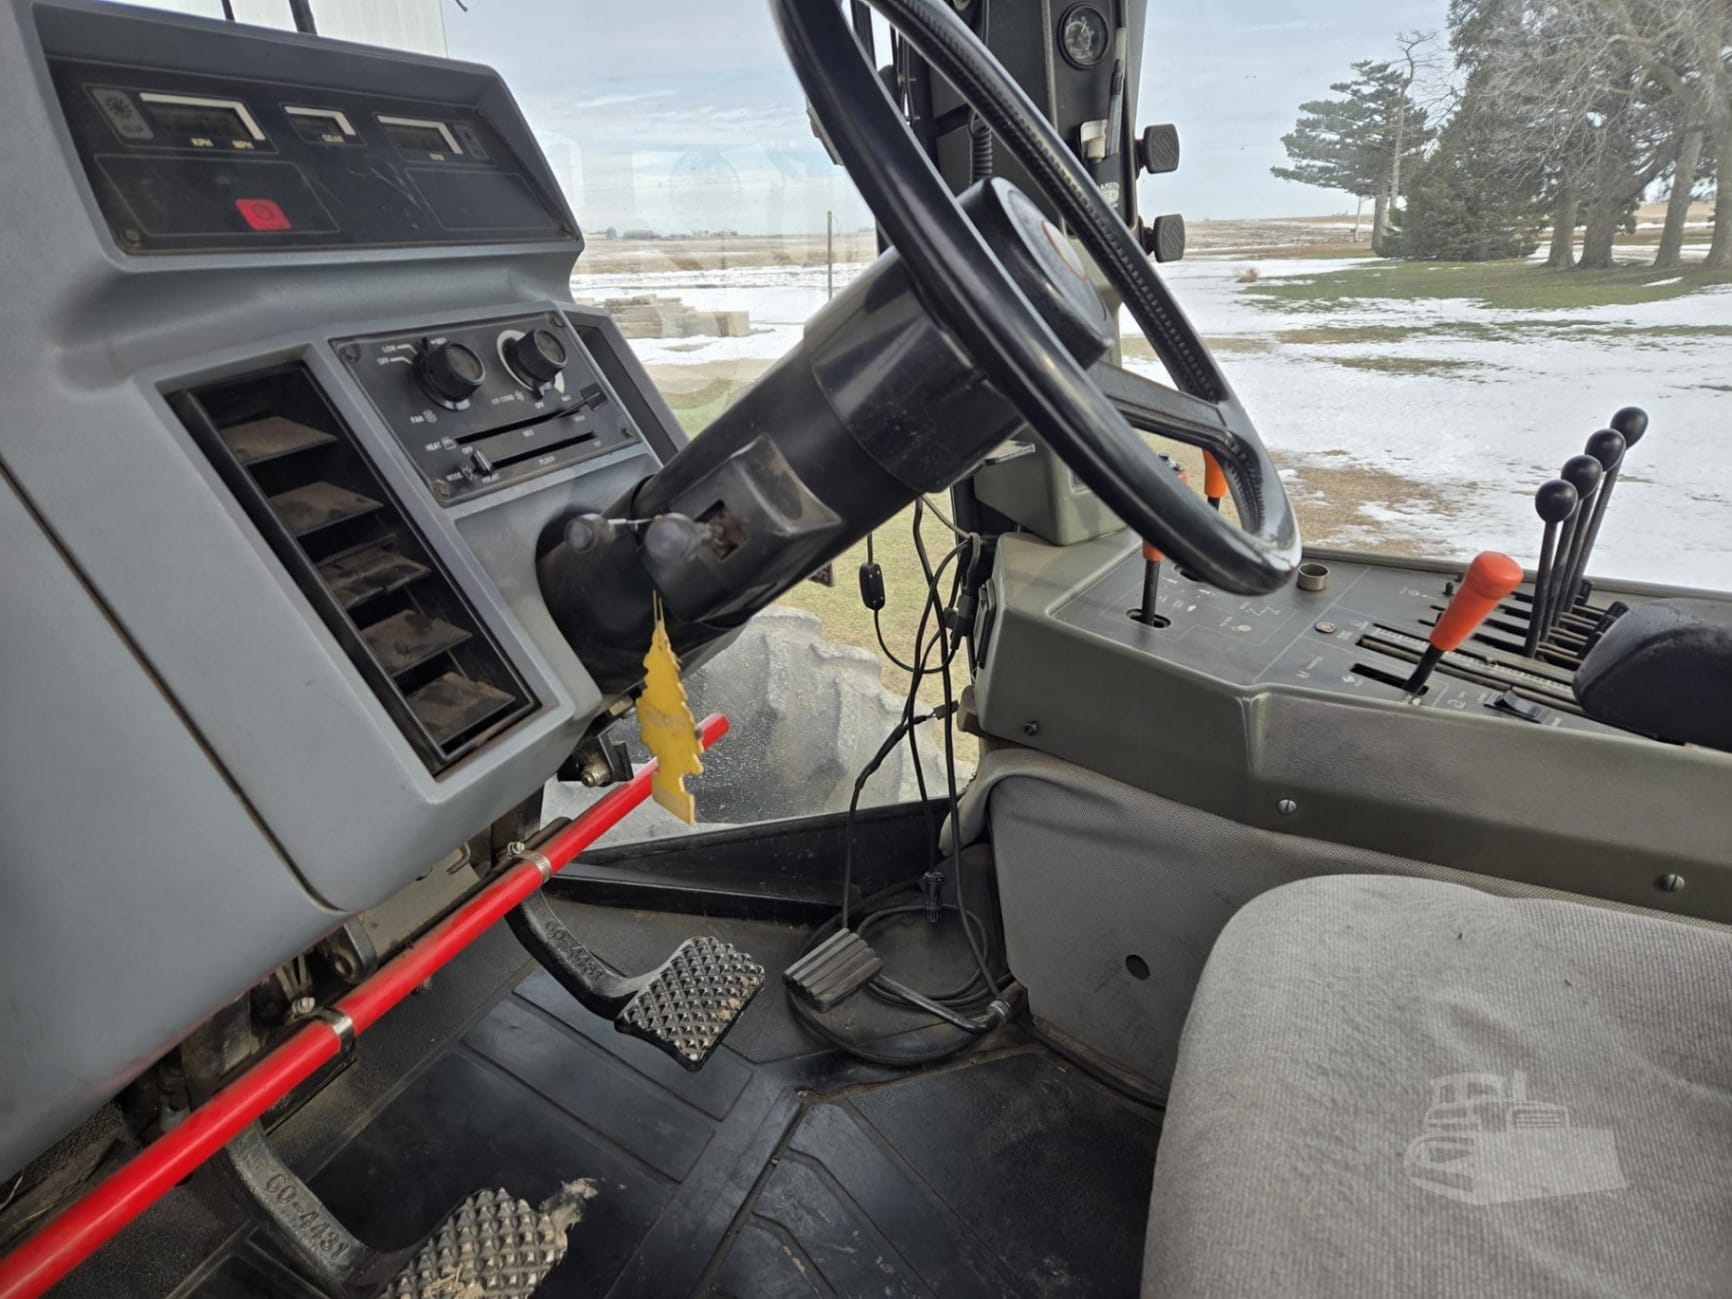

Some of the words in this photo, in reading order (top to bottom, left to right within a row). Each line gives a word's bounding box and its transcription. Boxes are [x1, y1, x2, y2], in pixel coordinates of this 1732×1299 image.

[190, 137, 214, 148] KPH
[321, 133, 345, 143] GEAR
[231, 139, 255, 150] MPH
